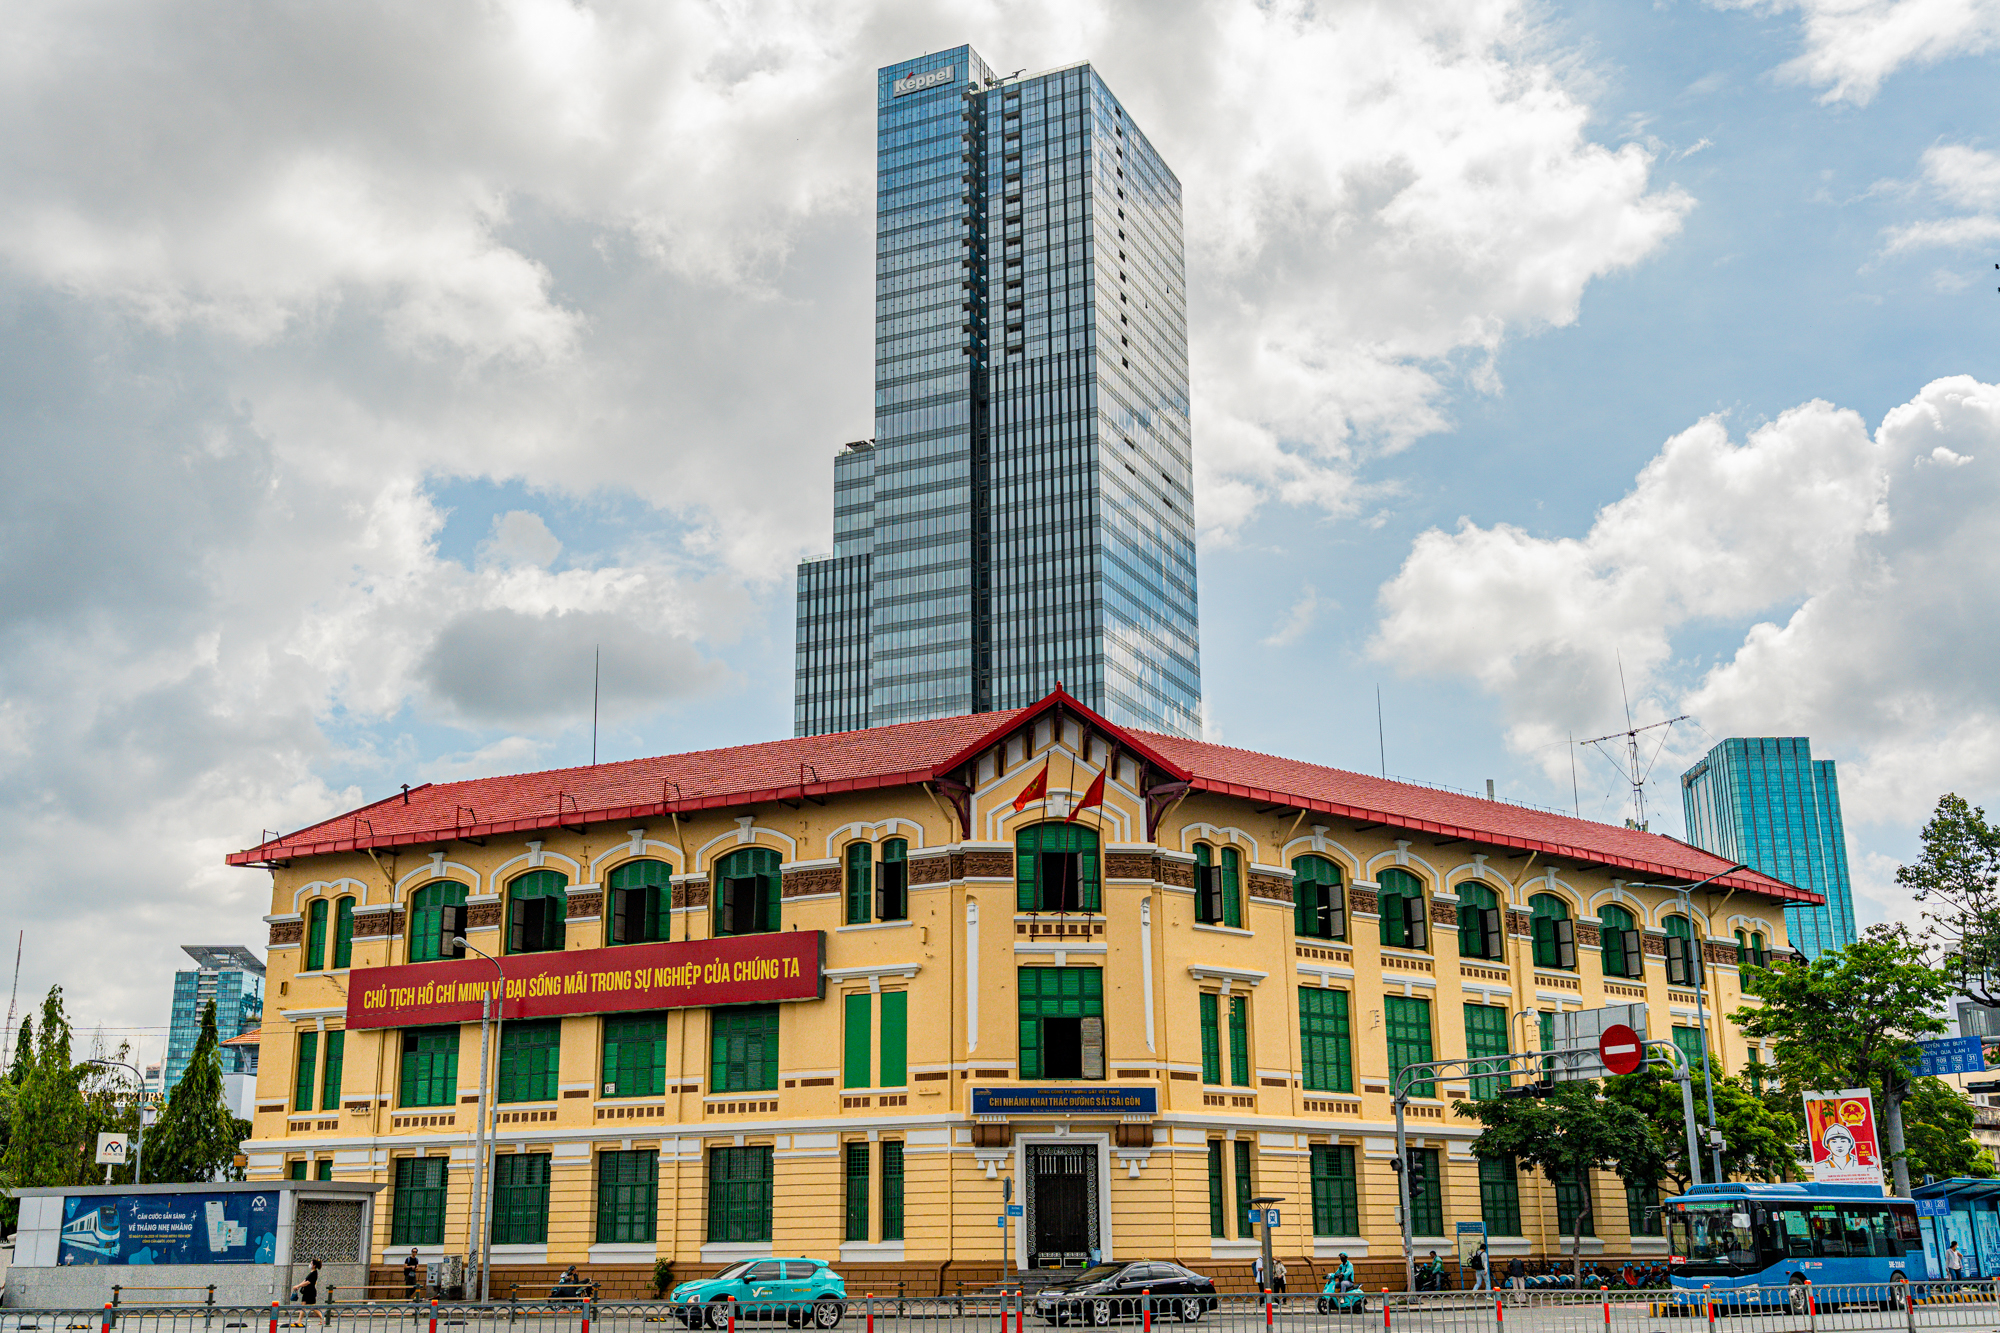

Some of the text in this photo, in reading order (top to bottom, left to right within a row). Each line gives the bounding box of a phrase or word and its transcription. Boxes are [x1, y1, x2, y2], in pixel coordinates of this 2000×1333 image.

[895, 65, 951, 93] Keppel
[364, 956, 800, 1011] CHỦ TỊCH HỒ CHÍ MINH V ĐẠI SỐNG MÃI TRONG SỰ NGHIỆP CỦA CHÚNG TA
[989, 1094, 1141, 1106] CHI NHÁNH KHAI THÁC ĐƯỜNG SẮT SÀI GÒN
[128, 1222, 193, 1233] VÉ THÁNG NHẸ NHÀNG
